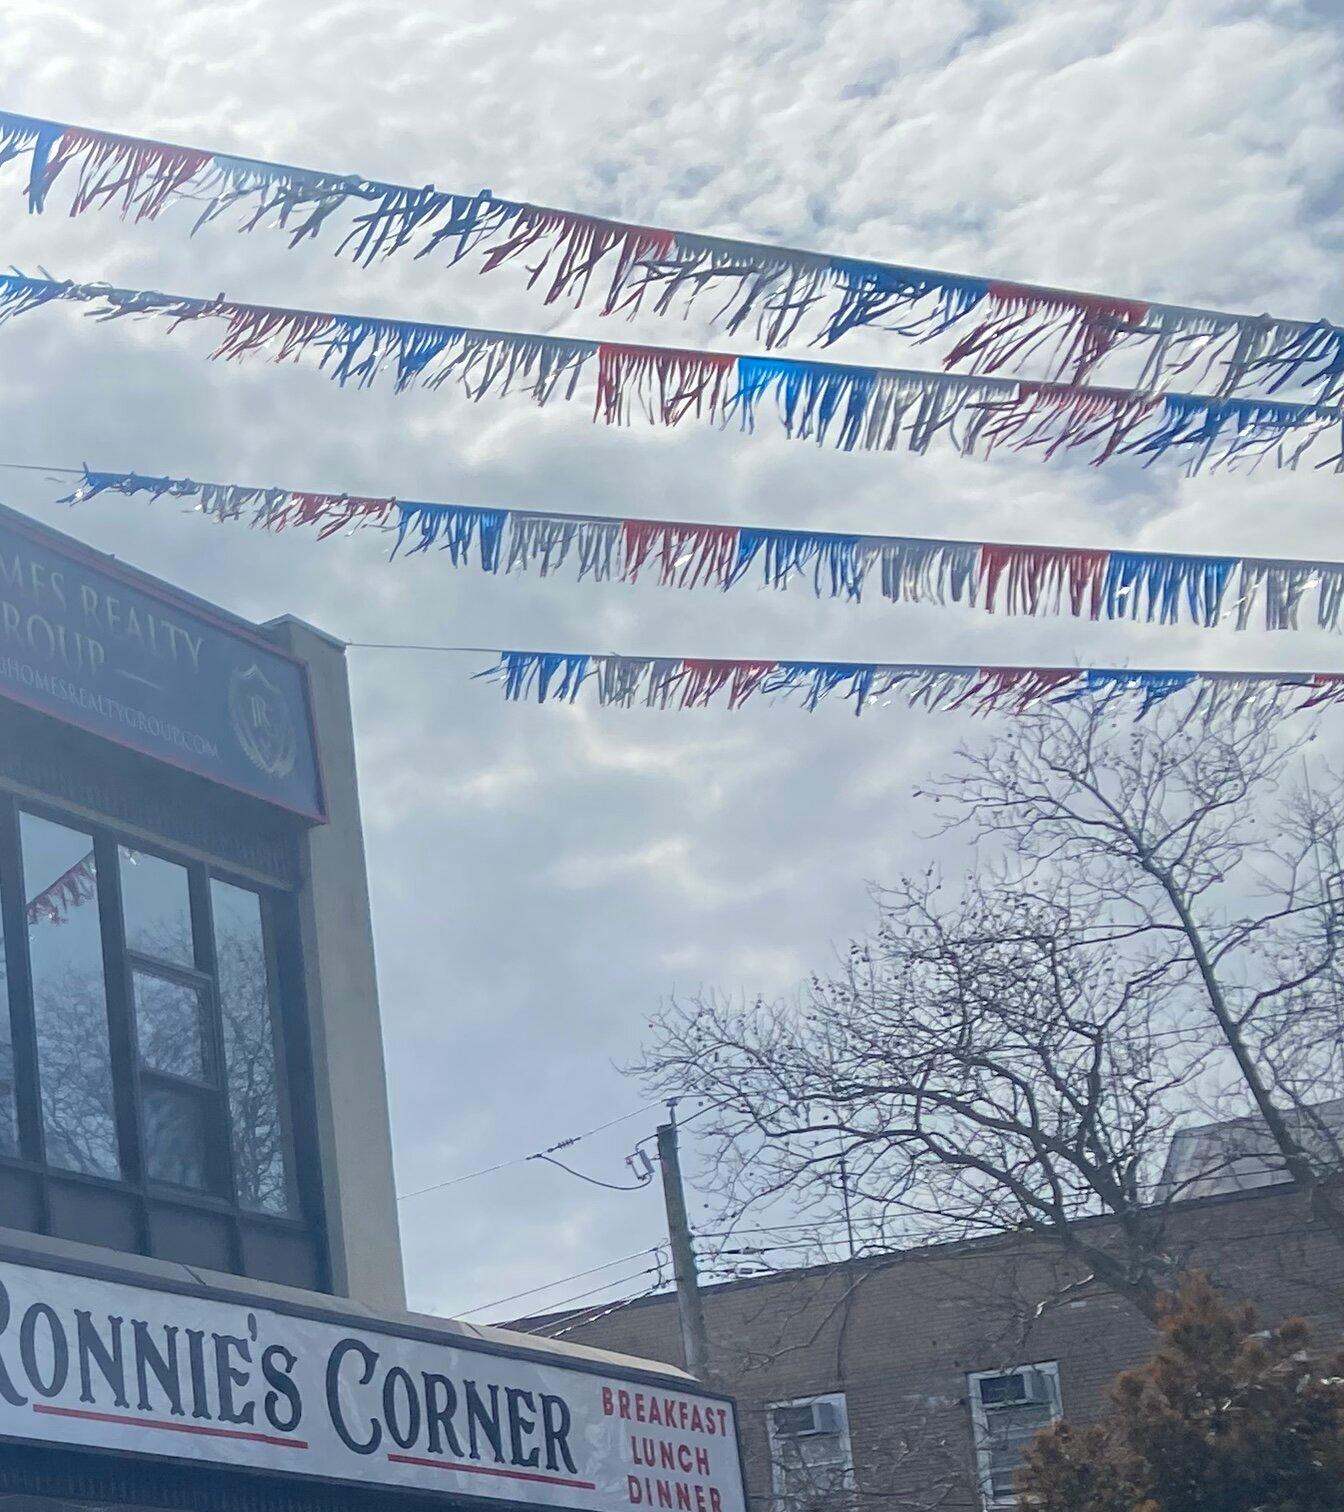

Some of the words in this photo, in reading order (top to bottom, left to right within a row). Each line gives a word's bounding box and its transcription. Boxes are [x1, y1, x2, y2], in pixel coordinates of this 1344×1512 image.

[81, 583, 205, 674] REALTY
[325, 1338, 579, 1475] CORNER
[602, 1385, 728, 1437] BREAKFAST
[630, 1434, 712, 1477] LUNCH
